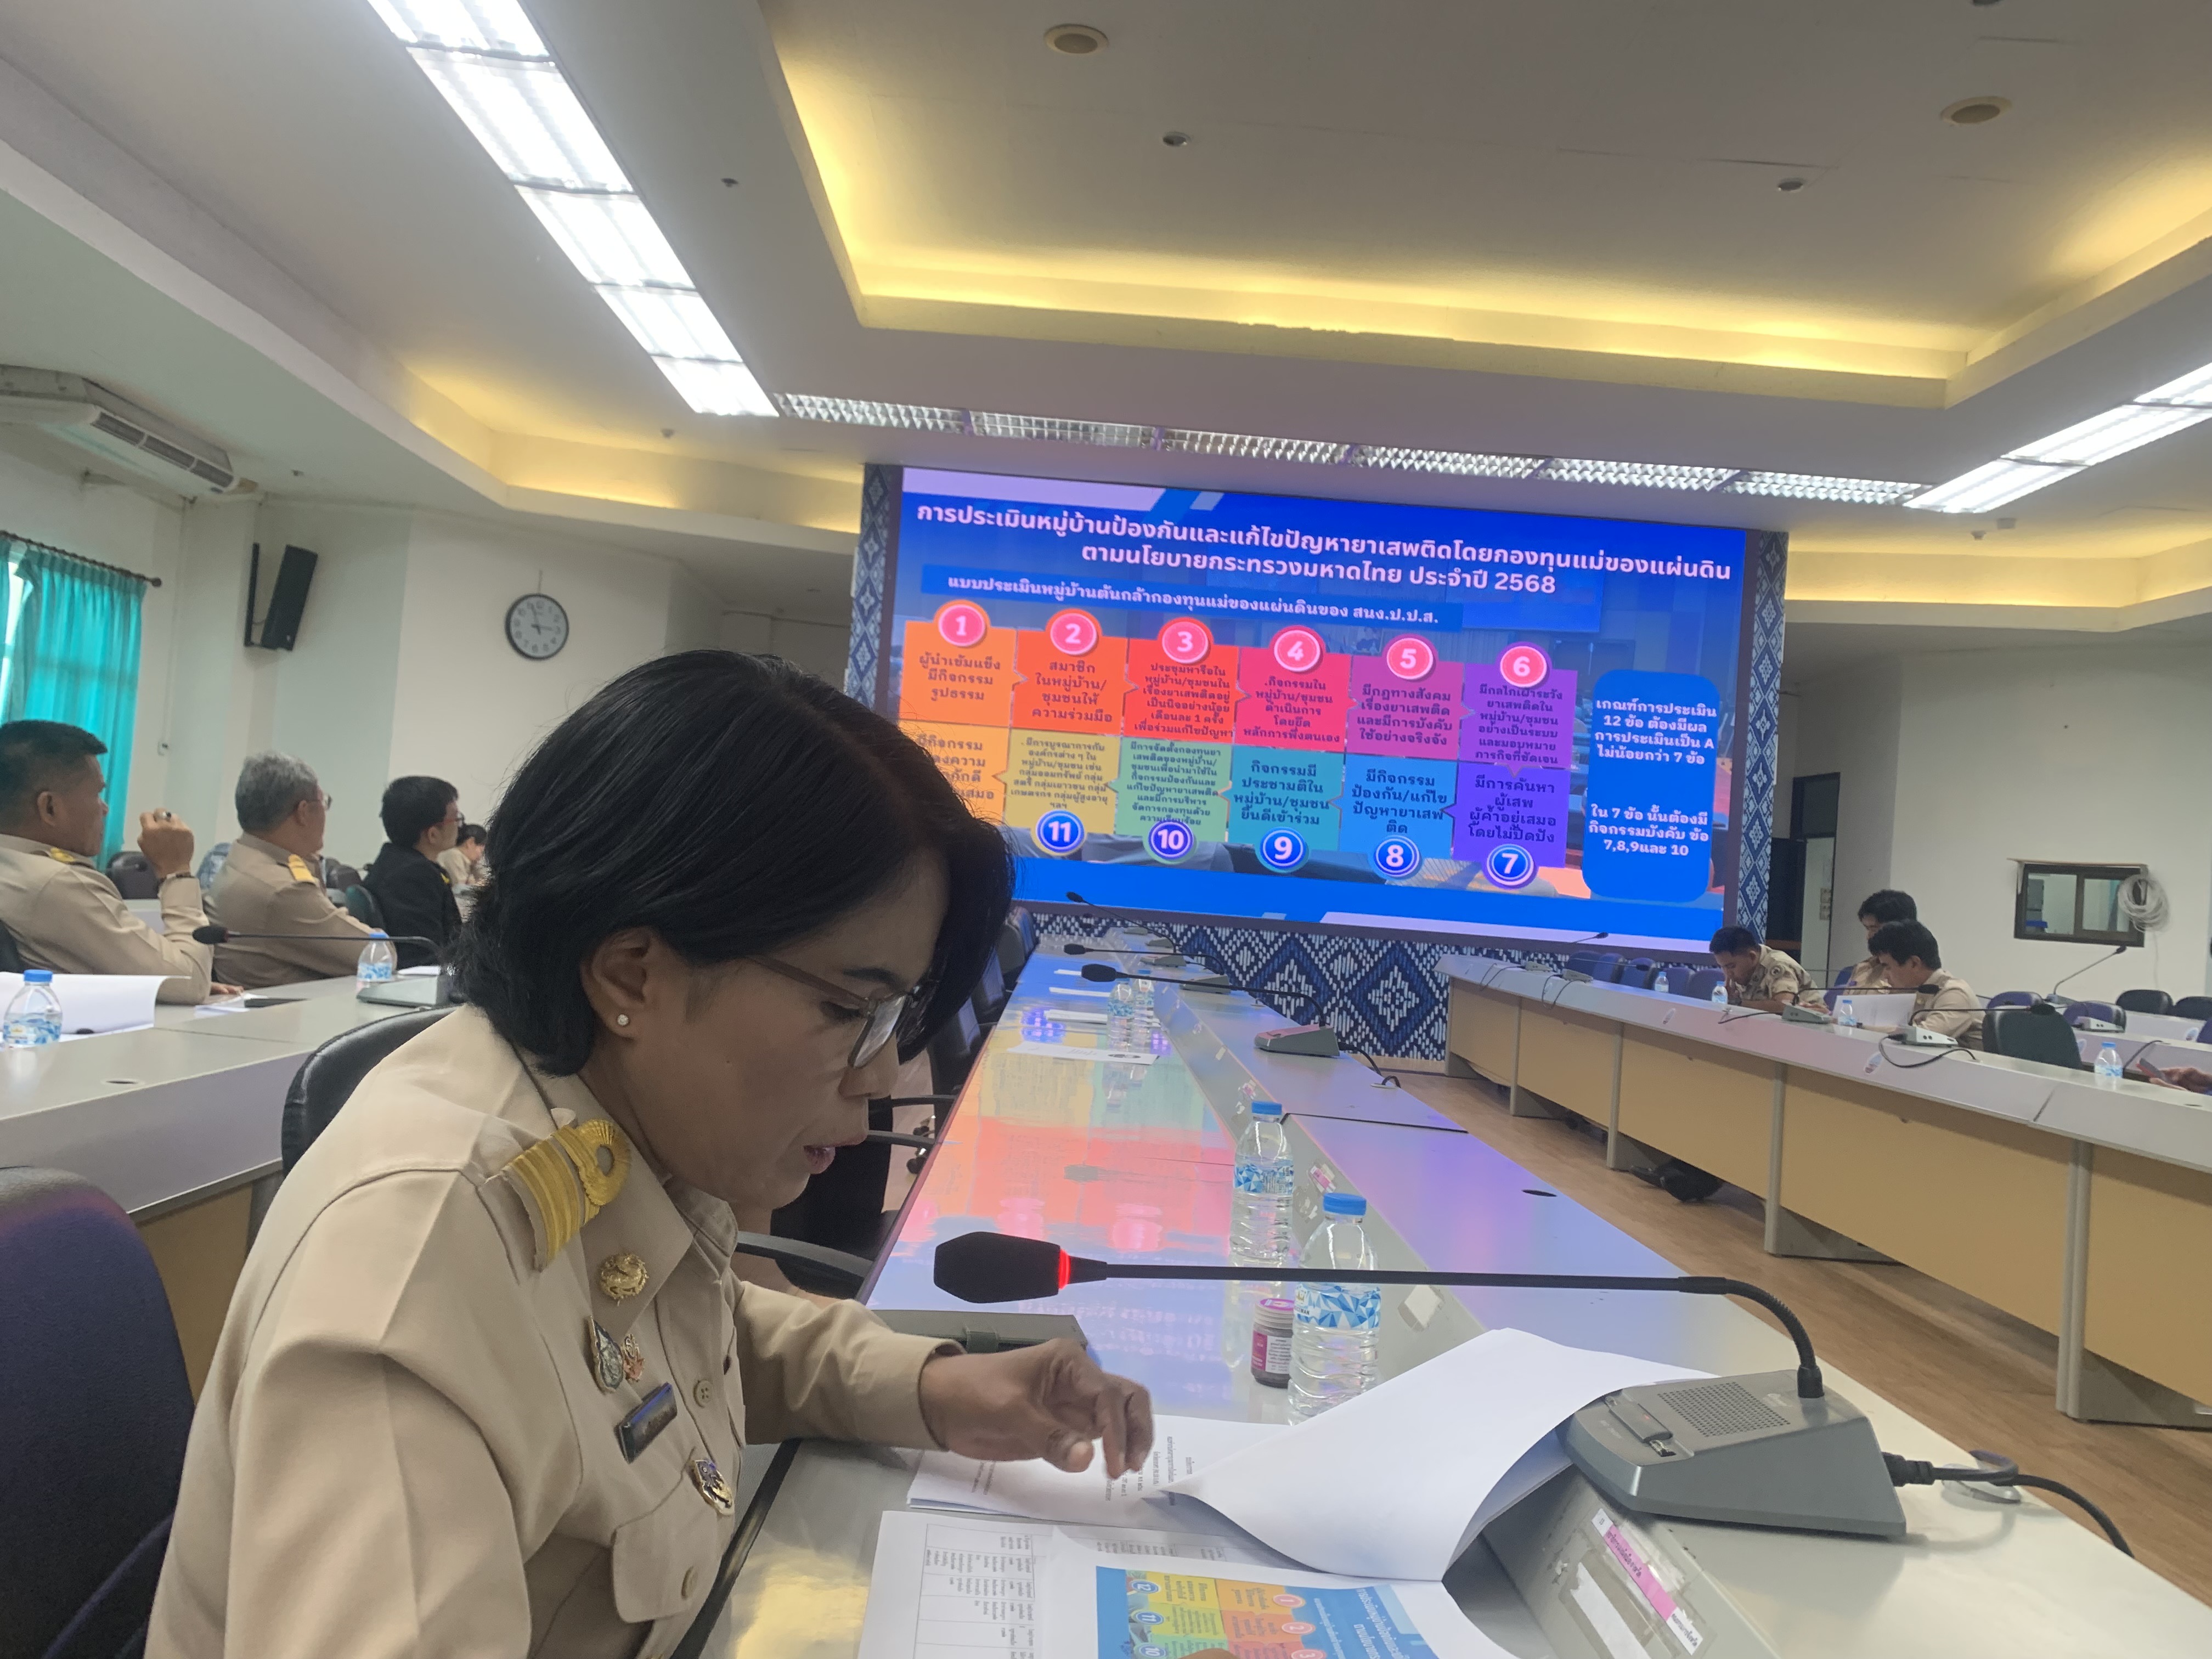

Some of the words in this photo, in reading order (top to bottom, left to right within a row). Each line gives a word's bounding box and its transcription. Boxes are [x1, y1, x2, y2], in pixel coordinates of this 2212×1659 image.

[917, 504, 1731, 580] การประเมินหมู่บ้านป้องกันและแก้ไขปัญหายาเสพติดโดยกองทุนแม่ของแผ่นดิน
[1082, 545, 1402, 584] ตามนโยบายกระทรวงมหาดไทย
[1410, 567, 1488, 590] ประจำปี
[1494, 572, 1556, 594] 2568
[948, 576, 1348, 618] แบบประเมินหมู่บ้านต้นกล้ากองทุนแม่ของแผ่นดินของ
[1353, 608, 1438, 624] สนง.ป.ป.ส.
[956, 616, 966, 636] 1
[1065, 623, 1081, 644] 2
[1177, 631, 1193, 652] 3
[1288, 641, 1304, 661] 4
[1049, 660, 1095, 673] สมาชิก
[1400, 648, 1417, 669] 5
[1513, 656, 1531, 676] 6
[928, 668, 993, 685] มีกิจกรรม
[1036, 672, 1107, 692] ในหมู่บ้าน/
[931, 687, 984, 701] รูปธรรม
[1042, 692, 1099, 706] ชุมชนให้
[1032, 707, 1112, 722] ความร่วมมือ
[1361, 695, 1449, 715] เรื่องยาเสพติด
[1487, 699, 1553, 712] ยาเสพติดใน
[1596, 698, 1717, 718] เกณฑ์การประเมิน
[1204, 711, 1223, 724] ครั้ง
[1274, 714, 1311, 727] โดยยึด
[1357, 714, 1452, 731] และมีการบังคับ
[1604, 715, 1621, 727] 12
[1625, 714, 1644, 728] ข้อ
[1647, 716, 1707, 733] ต้องมีผล
[1359, 727, 1447, 745] ใช้อย่างจริงจัง
[1594, 731, 1701, 748] การประเมินเป็น
[1704, 738, 1714, 749] A
[1596, 743, 1669, 762] ไม่น้อยกว่า
[1674, 752, 1683, 763] 7
[1686, 751, 1705, 765] ข้อ
[1251, 759, 1317, 777] กิจกรรมมี
[1366, 768, 1435, 786] มีกิจกรรม
[1242, 777, 1323, 793] ประชามติใน
[1352, 783, 1447, 804] ป้องกัน/แก้ไข
[1475, 774, 1555, 793] มีการค้นหา
[1353, 800, 1443, 820] ปัญหายาเสพ
[1495, 792, 1533, 811] ผู้เสพ
[1591, 803, 1608, 818] ใน
[1612, 808, 1621, 819] 7
[1624, 806, 1643, 821] ข้อ
[1647, 804, 1708, 825] นั้นต้องมี
[1048, 821, 1071, 843] 11
[1386, 819, 1408, 833] ติด
[1589, 820, 1686, 840] กิจกรรมบังคับ
[1689, 827, 1709, 842] ข้อ
[1158, 829, 1184, 850] 10
[1274, 836, 1293, 860] 9
[1604, 839, 1667, 854] 7,8,9และ
[1671, 844, 1689, 856] 10
[1386, 844, 1404, 867] 8
[1502, 853, 1519, 874] 7
[1145, 1647, 1160, 1657] 10
